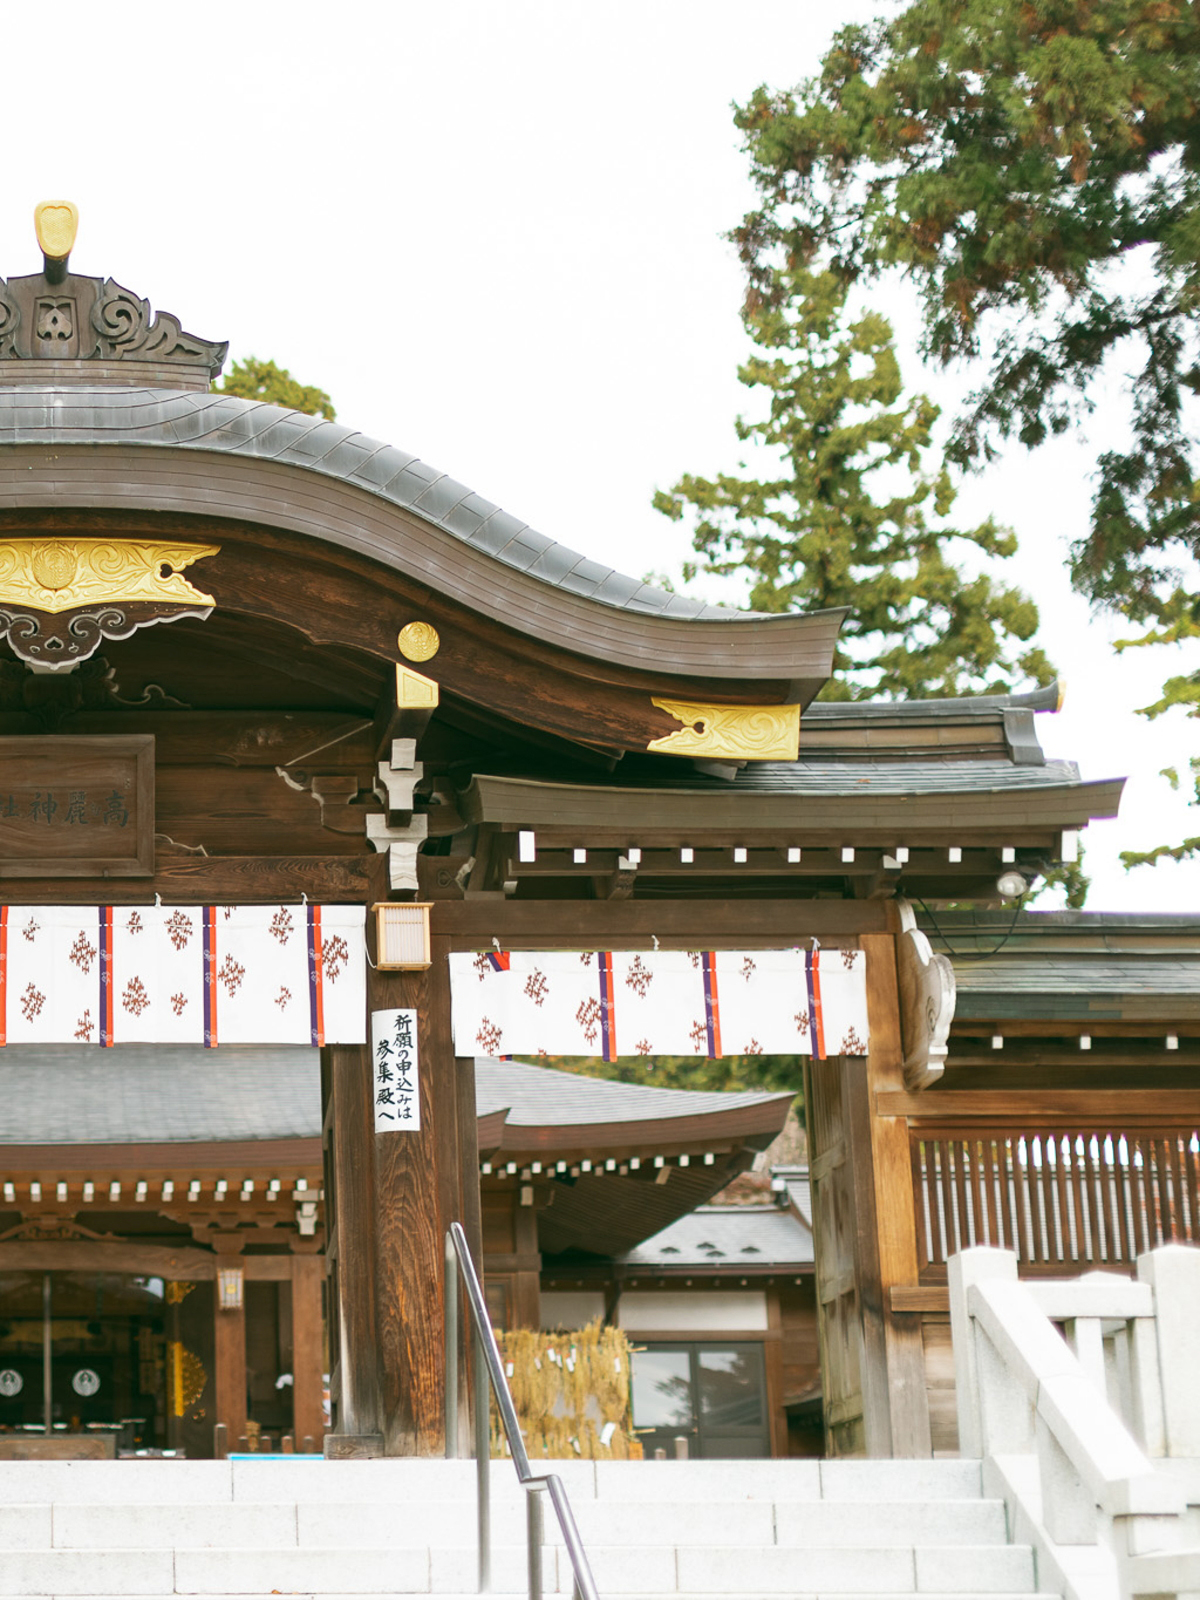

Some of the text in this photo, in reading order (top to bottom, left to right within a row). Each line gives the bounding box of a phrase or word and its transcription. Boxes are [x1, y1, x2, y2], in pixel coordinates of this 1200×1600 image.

[375, 1039, 395, 1121] 参集殿へ
[392, 1014, 414, 1119] 祈願の申込みは
